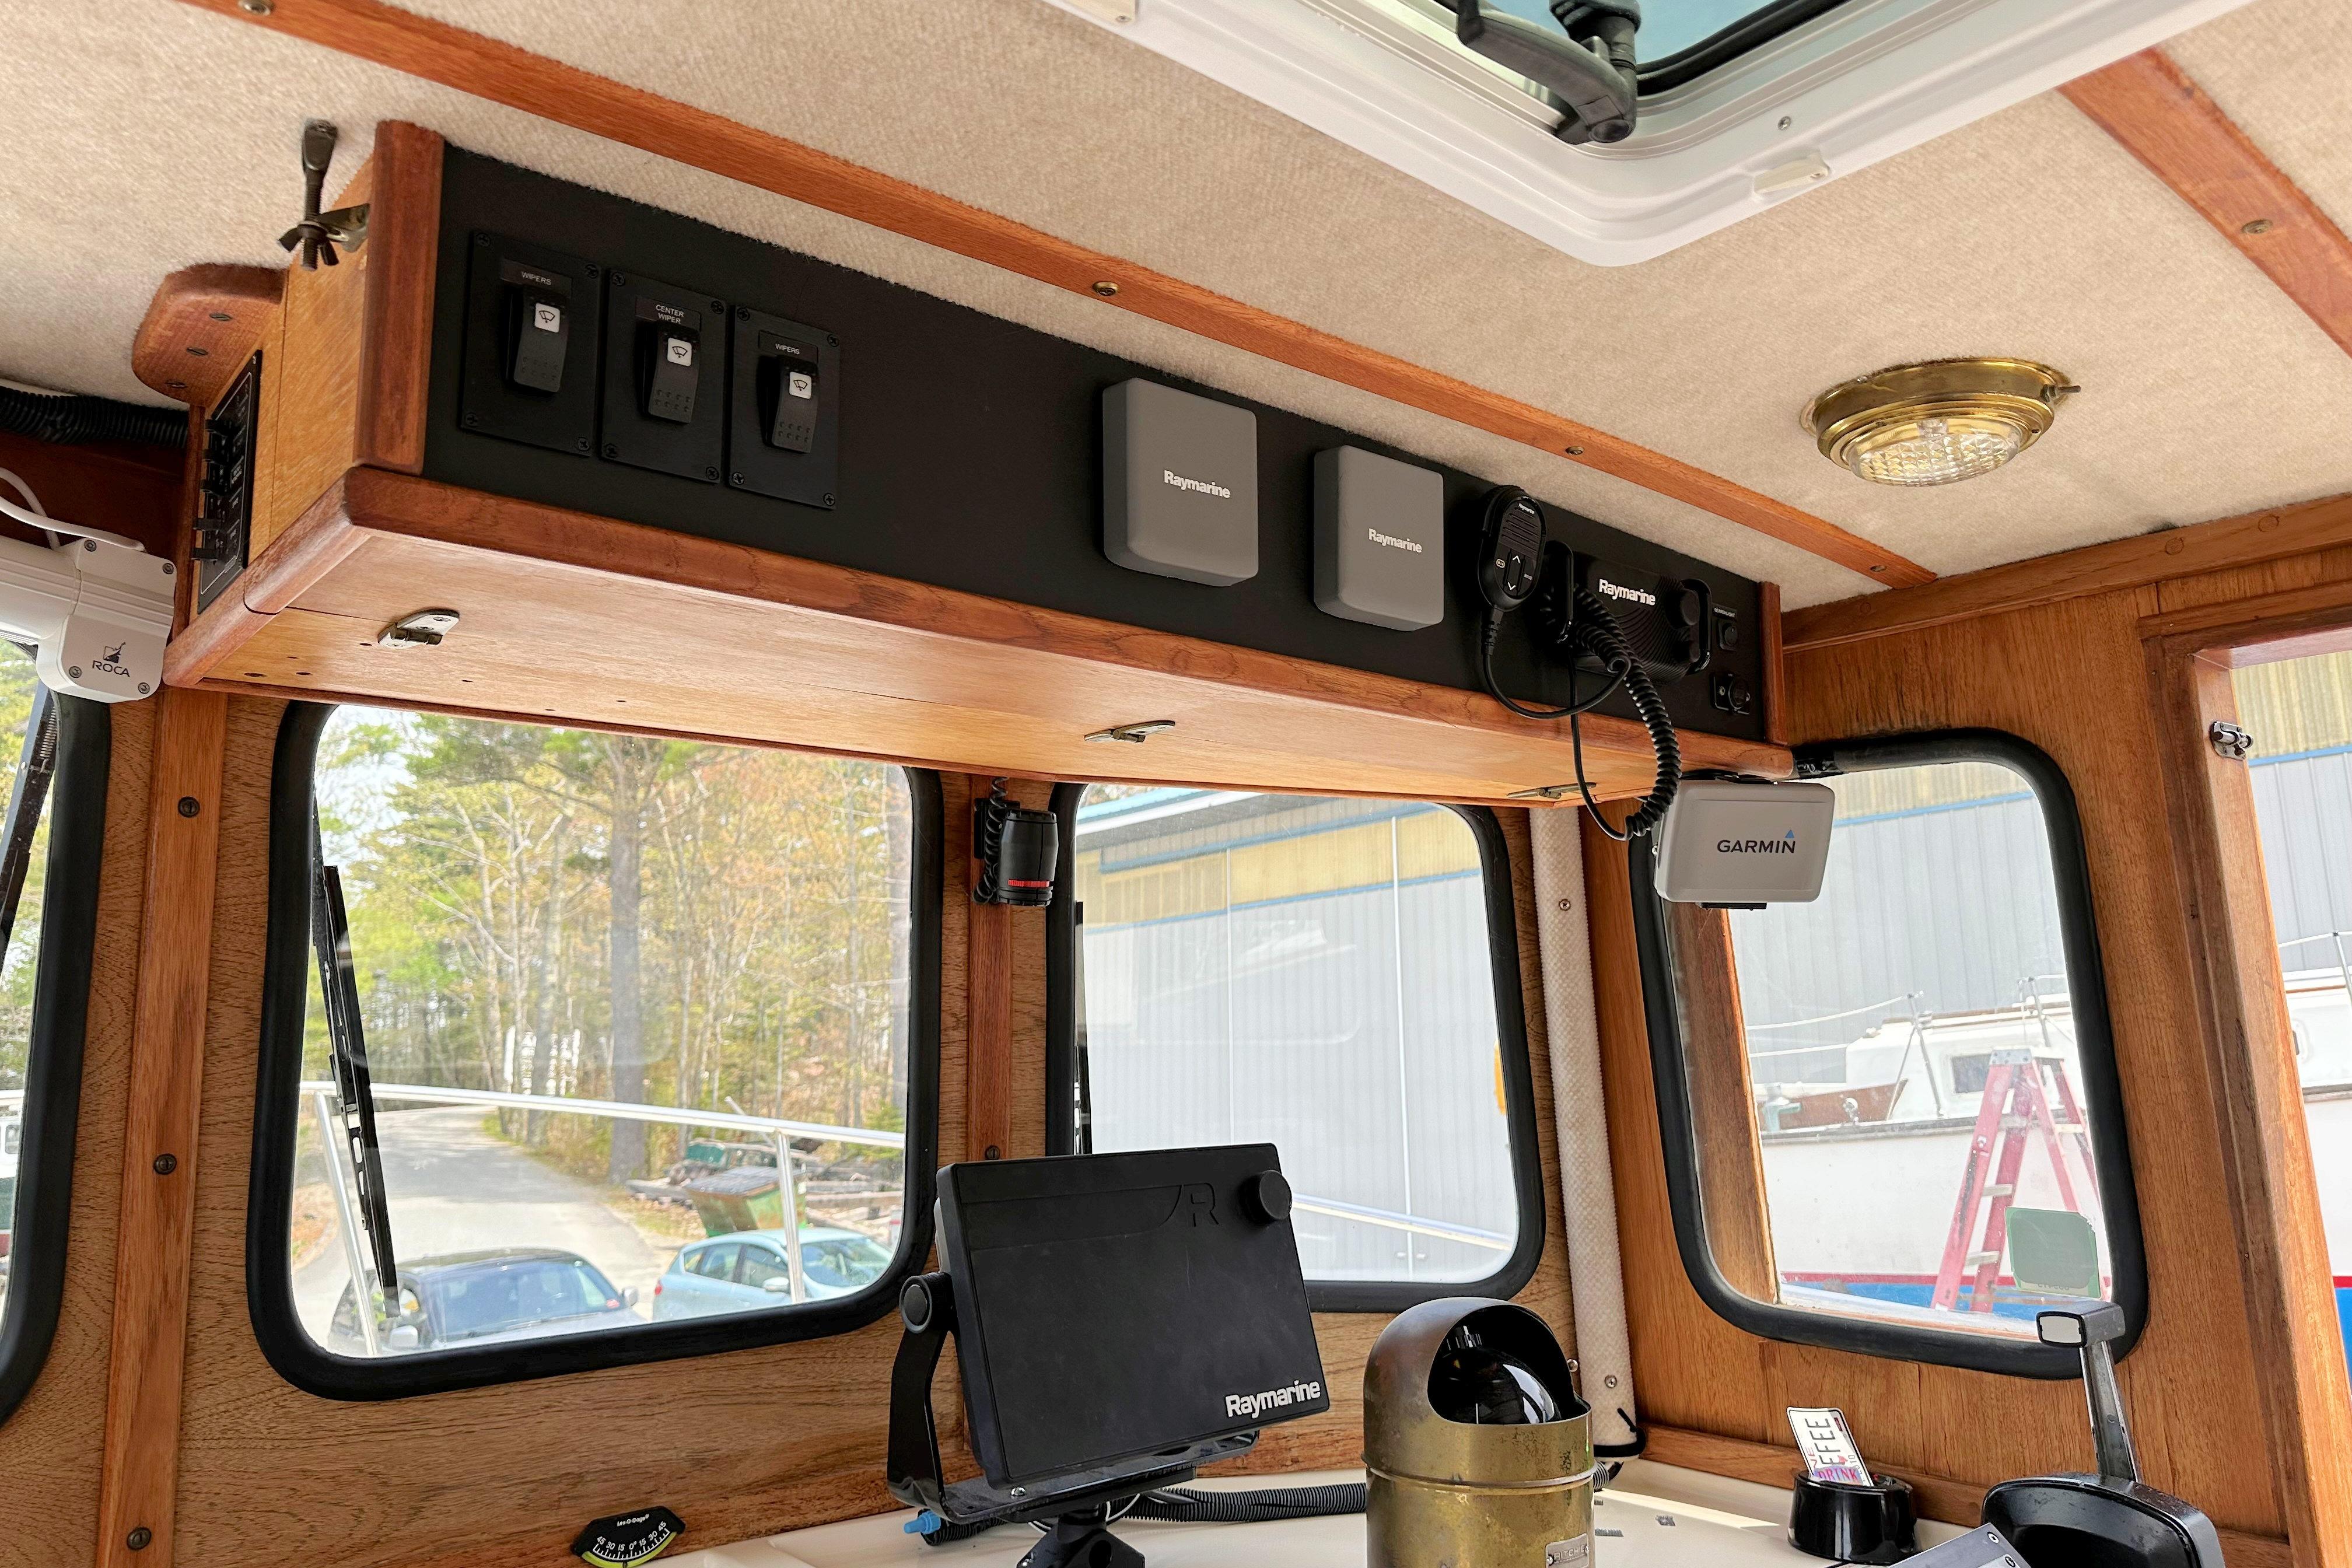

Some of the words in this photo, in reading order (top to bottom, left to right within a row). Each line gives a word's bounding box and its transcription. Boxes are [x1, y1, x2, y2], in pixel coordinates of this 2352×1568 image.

[522, 271, 551, 285] WIPERS
[656, 304, 684, 317] CENTER
[658, 312, 681, 324] WIPER
[1164, 470, 1231, 498] Raymarine
[1368, 528, 1422, 553] Raymarine
[1599, 579, 1656, 606] Raymarine
[92, 660, 130, 677] ROCA
[1717, 839, 1796, 854] GARMIN
[1225, 1380, 1321, 1419] Raymarine
[1818, 1468, 1858, 1482] DRINK
[597, 1536, 607, 1545] 45
[606, 1541, 616, 1550] 30
[618, 1544, 625, 1552] 15
[639, 1538, 646, 1547] 15
[648, 1530, 658, 1541] 30
[658, 1521, 667, 1531] 45
[1553, 1544, 1586, 1561] RITCHIE
